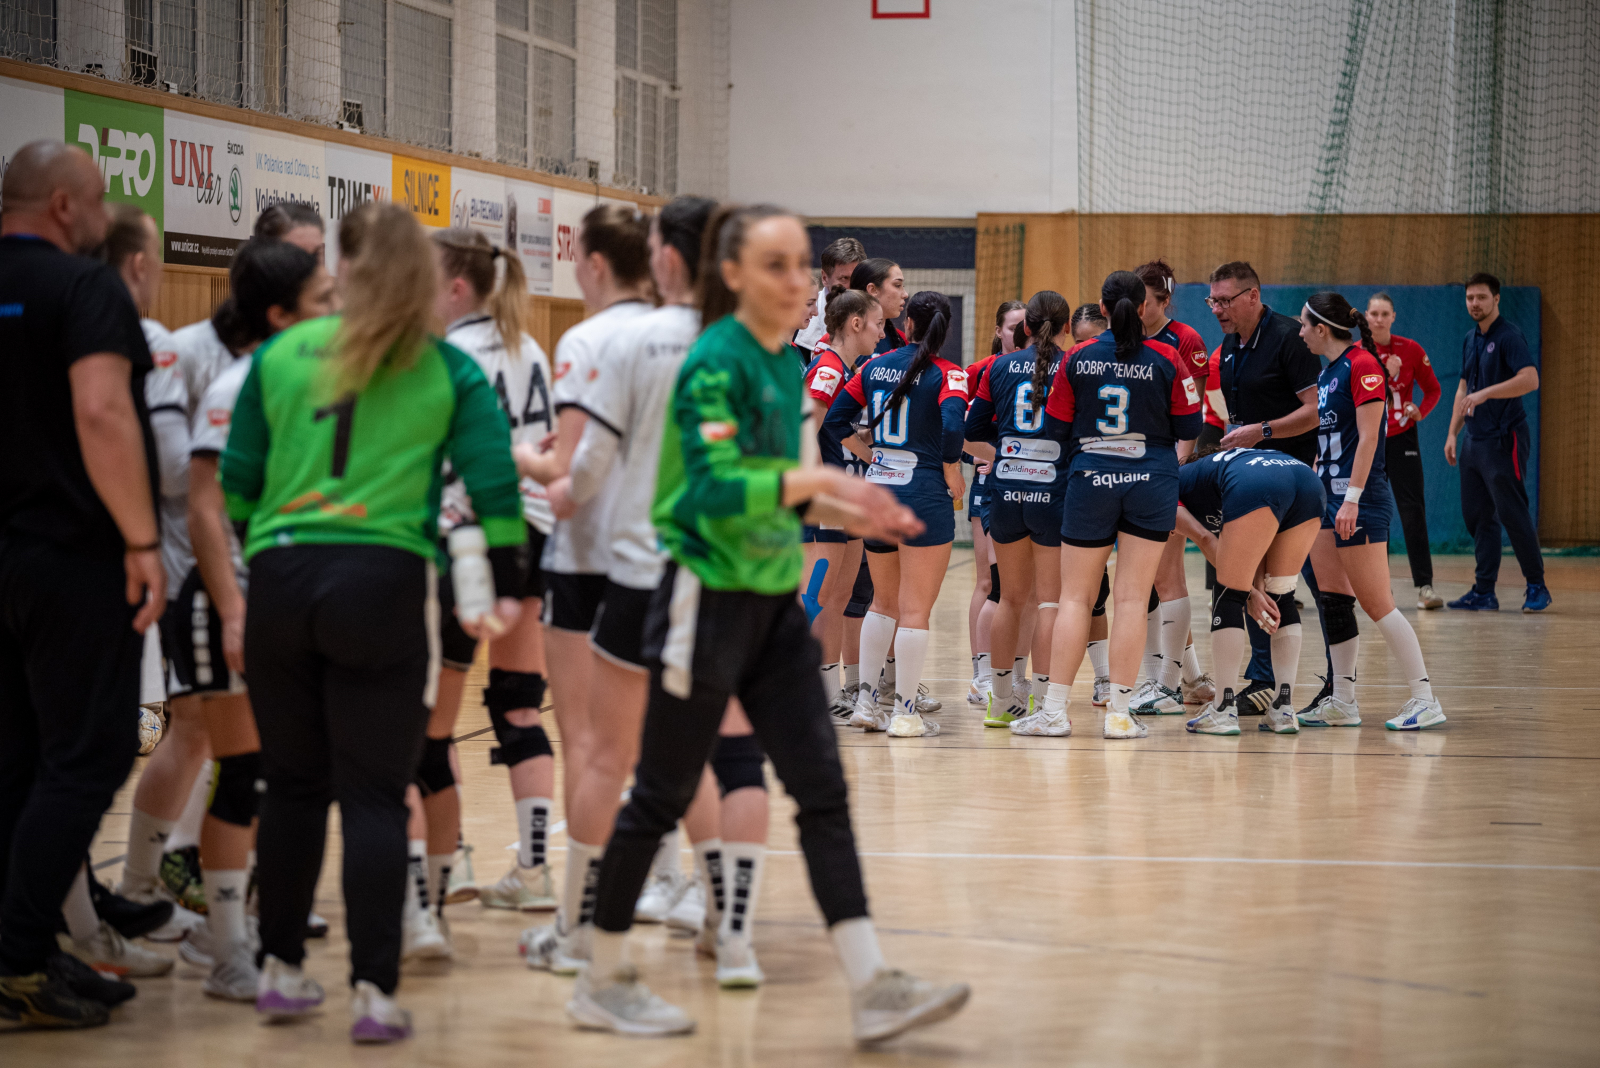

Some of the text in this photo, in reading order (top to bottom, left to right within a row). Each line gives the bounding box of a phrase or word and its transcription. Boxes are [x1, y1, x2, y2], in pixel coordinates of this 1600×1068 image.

[170, 138, 213, 190] UNI
[227, 140, 244, 156] ŠKODA
[290, 192, 320, 216] Plka
[404, 169, 439, 216] SILNICE
[870, 366, 924, 386] CABADAÁ
[1008, 360, 1061, 375] Ka.RAVÁ
[872, 389, 911, 446] 10
[1014, 380, 1047, 433] 6
[1096, 384, 1131, 436] 3
